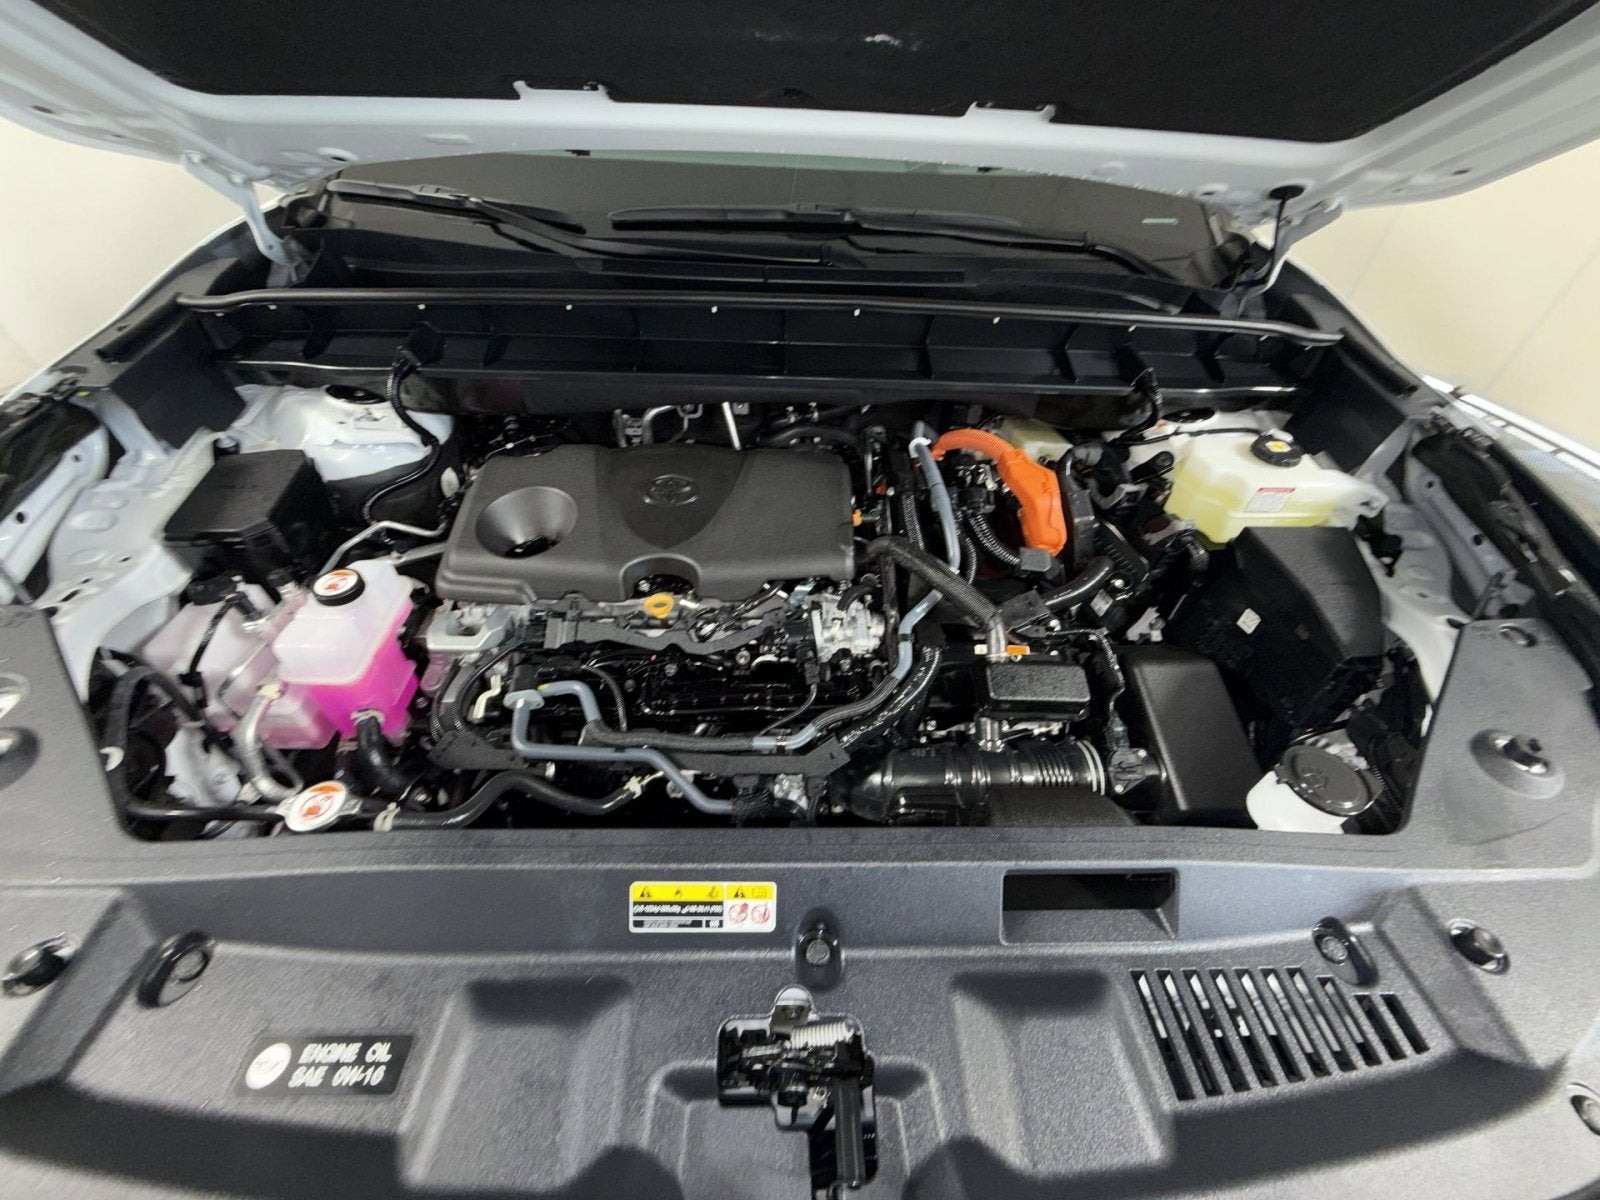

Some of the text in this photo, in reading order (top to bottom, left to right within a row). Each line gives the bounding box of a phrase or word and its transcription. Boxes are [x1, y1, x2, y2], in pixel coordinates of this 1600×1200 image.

[298, 1042, 392, 1063] ENGINE OIL
[288, 1065, 328, 1087] SAE
